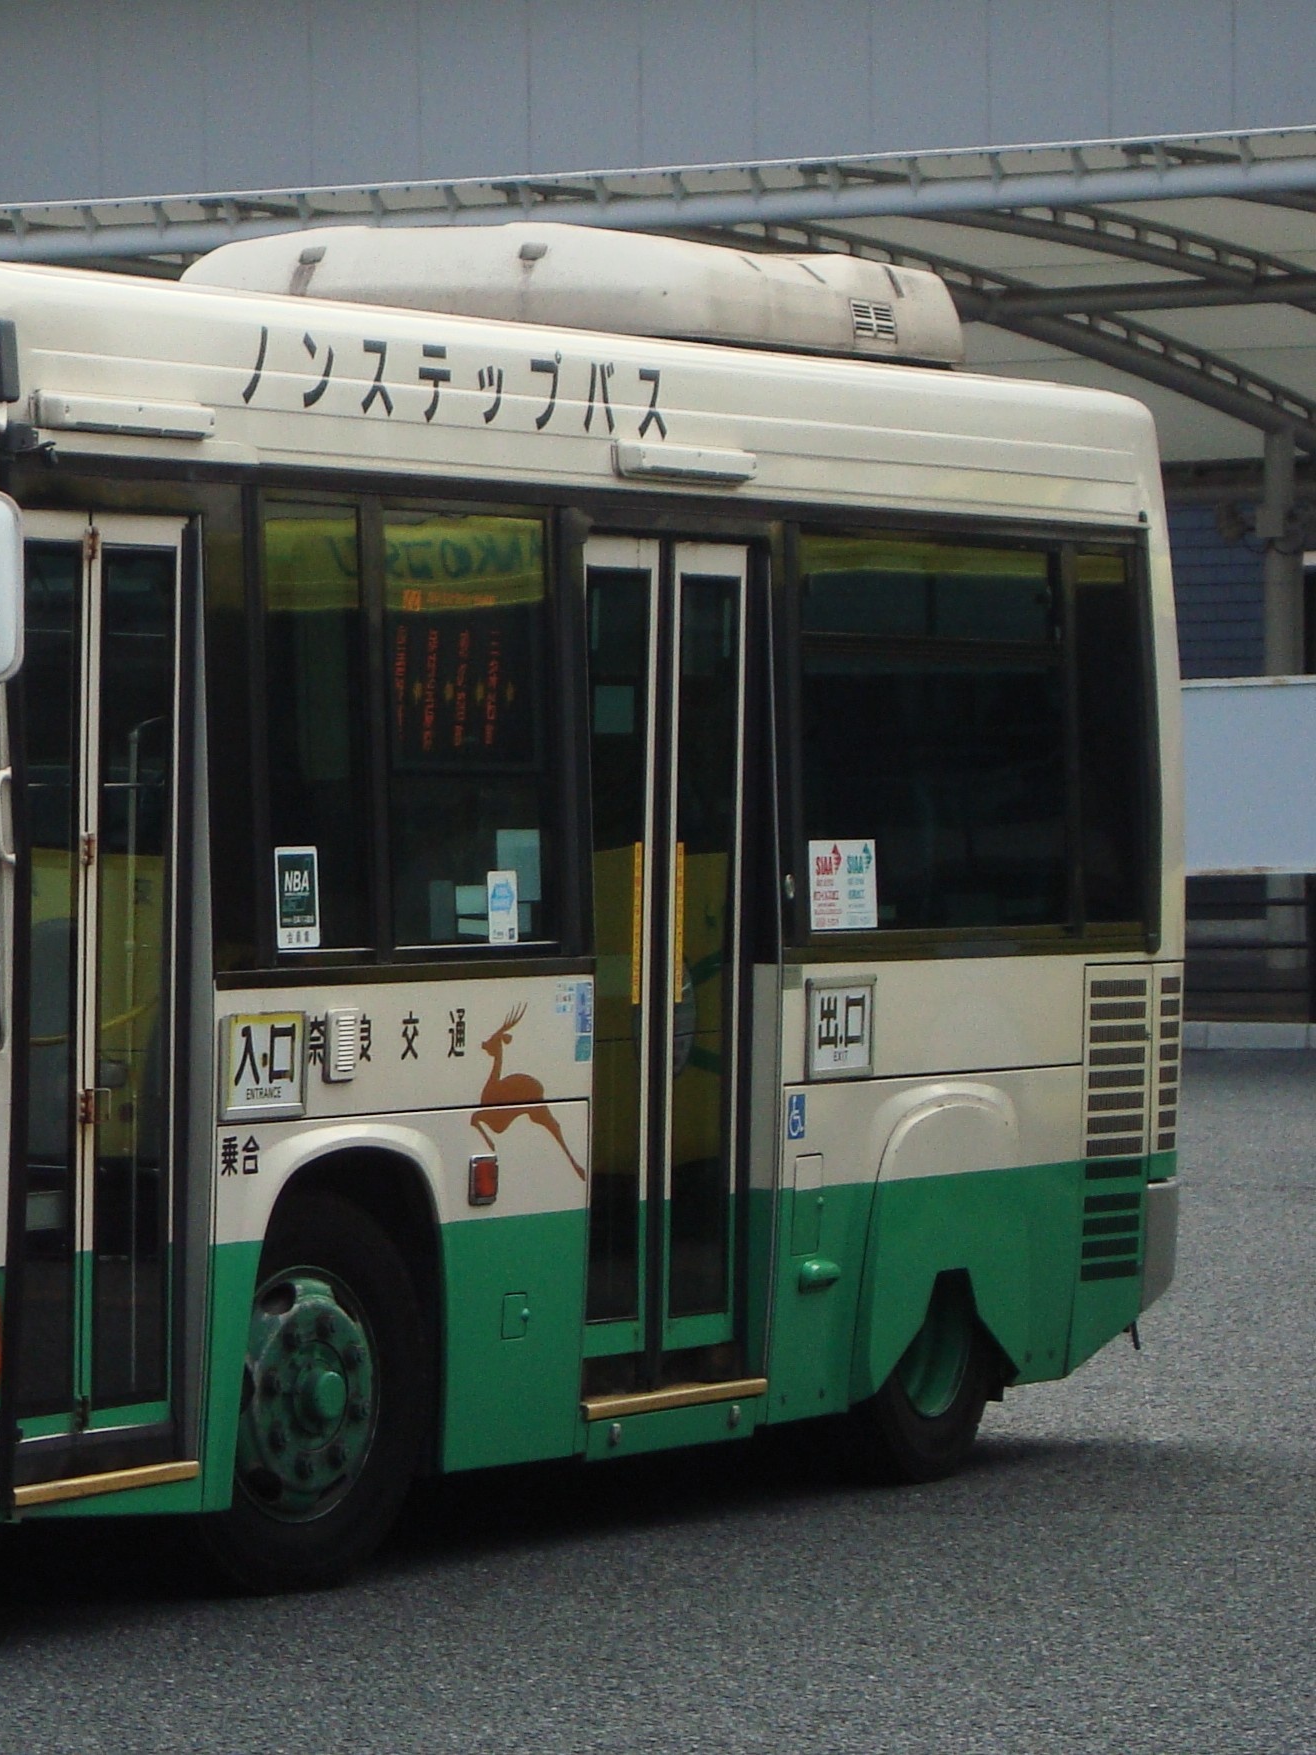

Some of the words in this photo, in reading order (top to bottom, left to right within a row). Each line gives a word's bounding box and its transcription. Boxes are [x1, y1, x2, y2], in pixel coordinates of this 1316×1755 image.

[241, 325, 667, 441] ノンステップバス
[284, 870, 310, 893] NBA
[818, 993, 866, 1050] 出口
[234, 1022, 297, 1086] 入口
[833, 1049, 849, 1062] EXIT
[246, 1086, 282, 1100] ENTRANCE
[220, 1135, 260, 1177] 乗合
